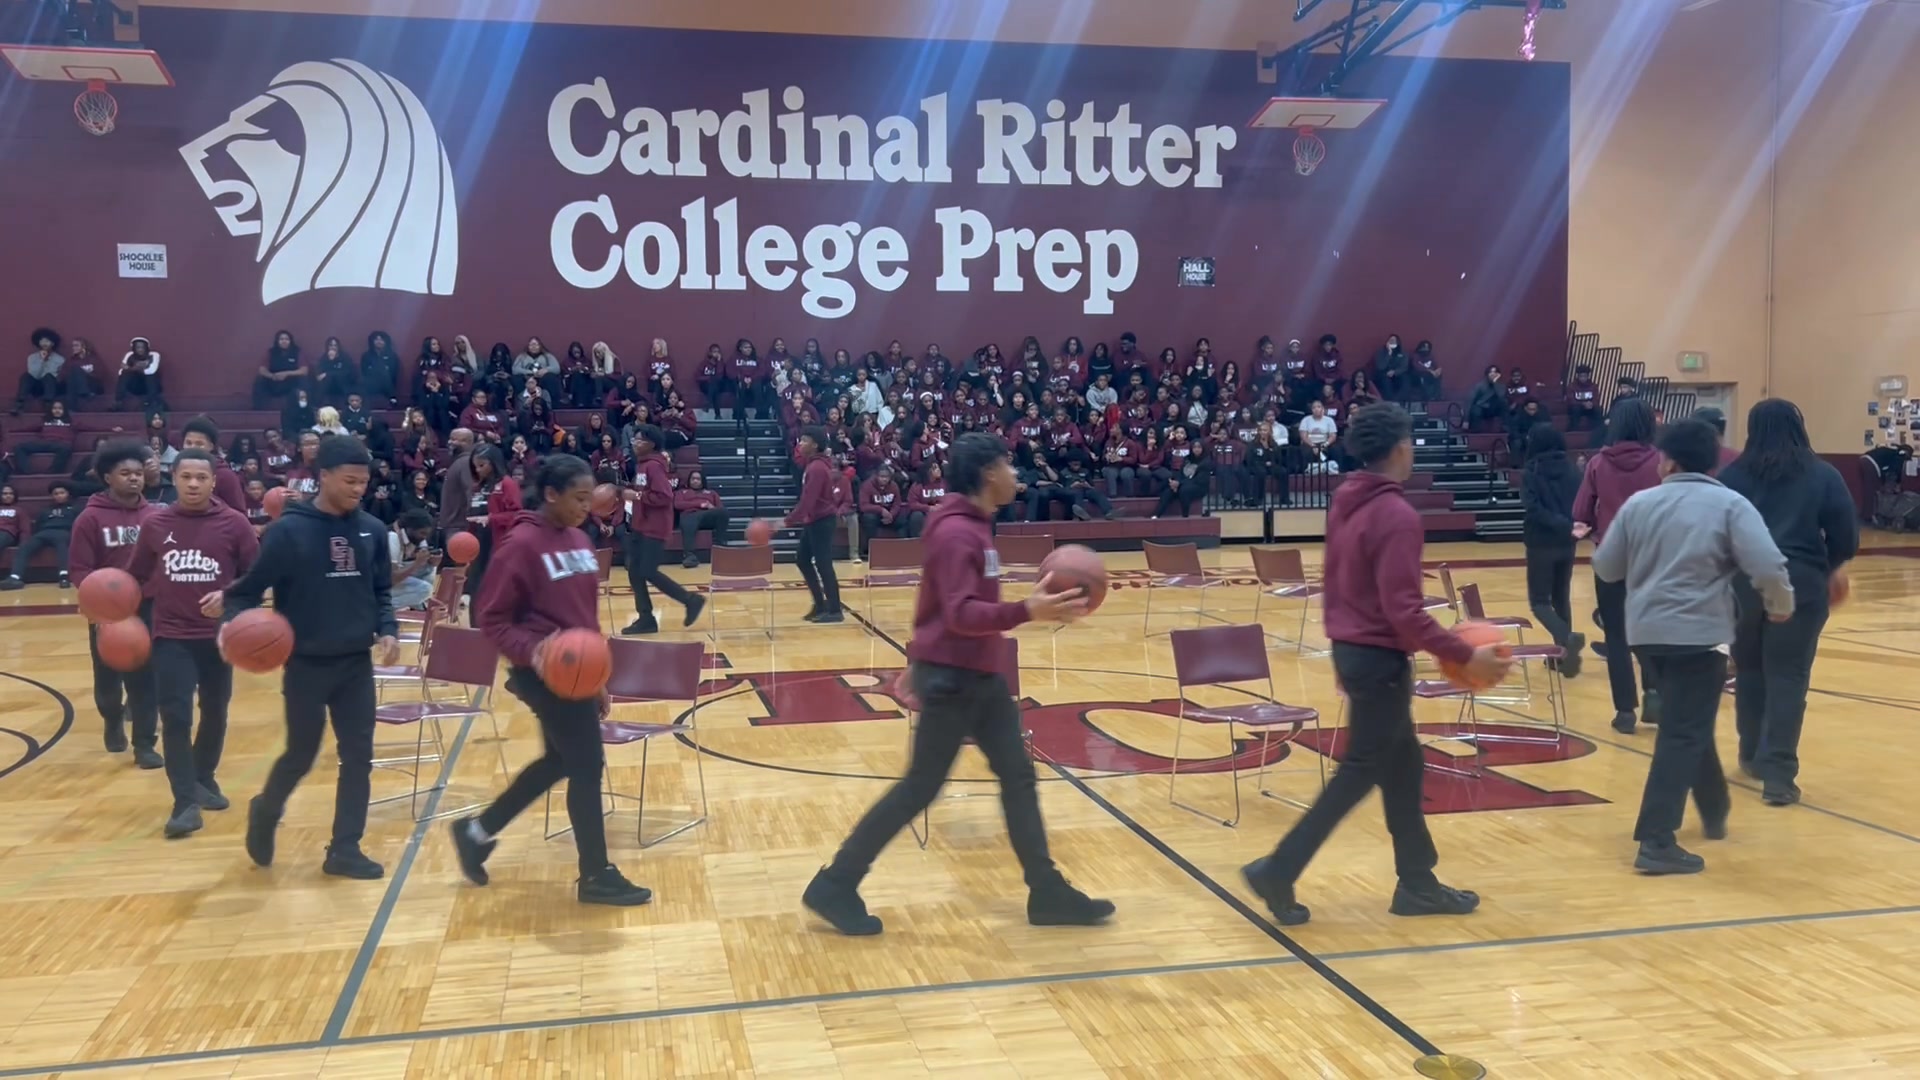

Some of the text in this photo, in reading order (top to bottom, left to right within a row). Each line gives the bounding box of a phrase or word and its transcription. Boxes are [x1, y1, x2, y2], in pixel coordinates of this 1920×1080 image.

[548, 77, 1237, 189] Cardinal Ritter
[550, 194, 1139, 318] College Prep
[129, 262, 156, 270] HOUSE
[1183, 262, 1210, 272] HALL
[163, 549, 222, 575] Ritter
[170, 573, 216, 582] FOOTBALL
